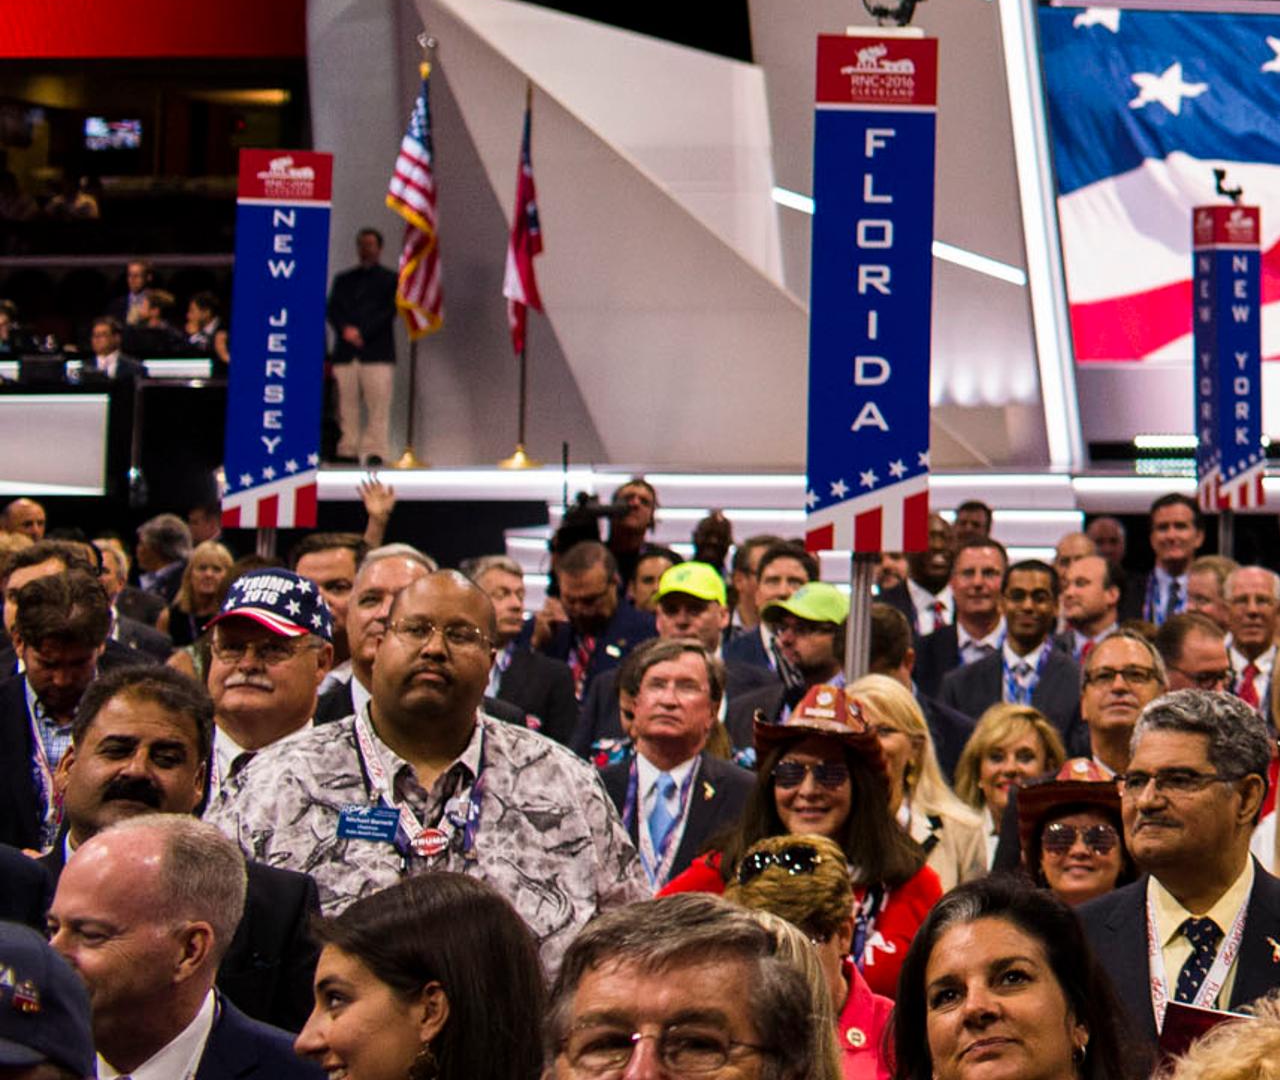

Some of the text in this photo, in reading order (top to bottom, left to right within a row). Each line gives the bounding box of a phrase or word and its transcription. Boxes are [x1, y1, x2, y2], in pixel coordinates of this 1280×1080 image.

[267, 208, 297, 280] NEW
[850, 128, 896, 432] FLORIDA
[1231, 254, 1251, 324] NEW
[261, 307, 288, 456] JERSEY
[1233, 351, 1250, 446] YORK
[241, 590, 279, 605] 2016
[242, 575, 294, 594] TRUMP
[411, 835, 449, 846] TRUMP
